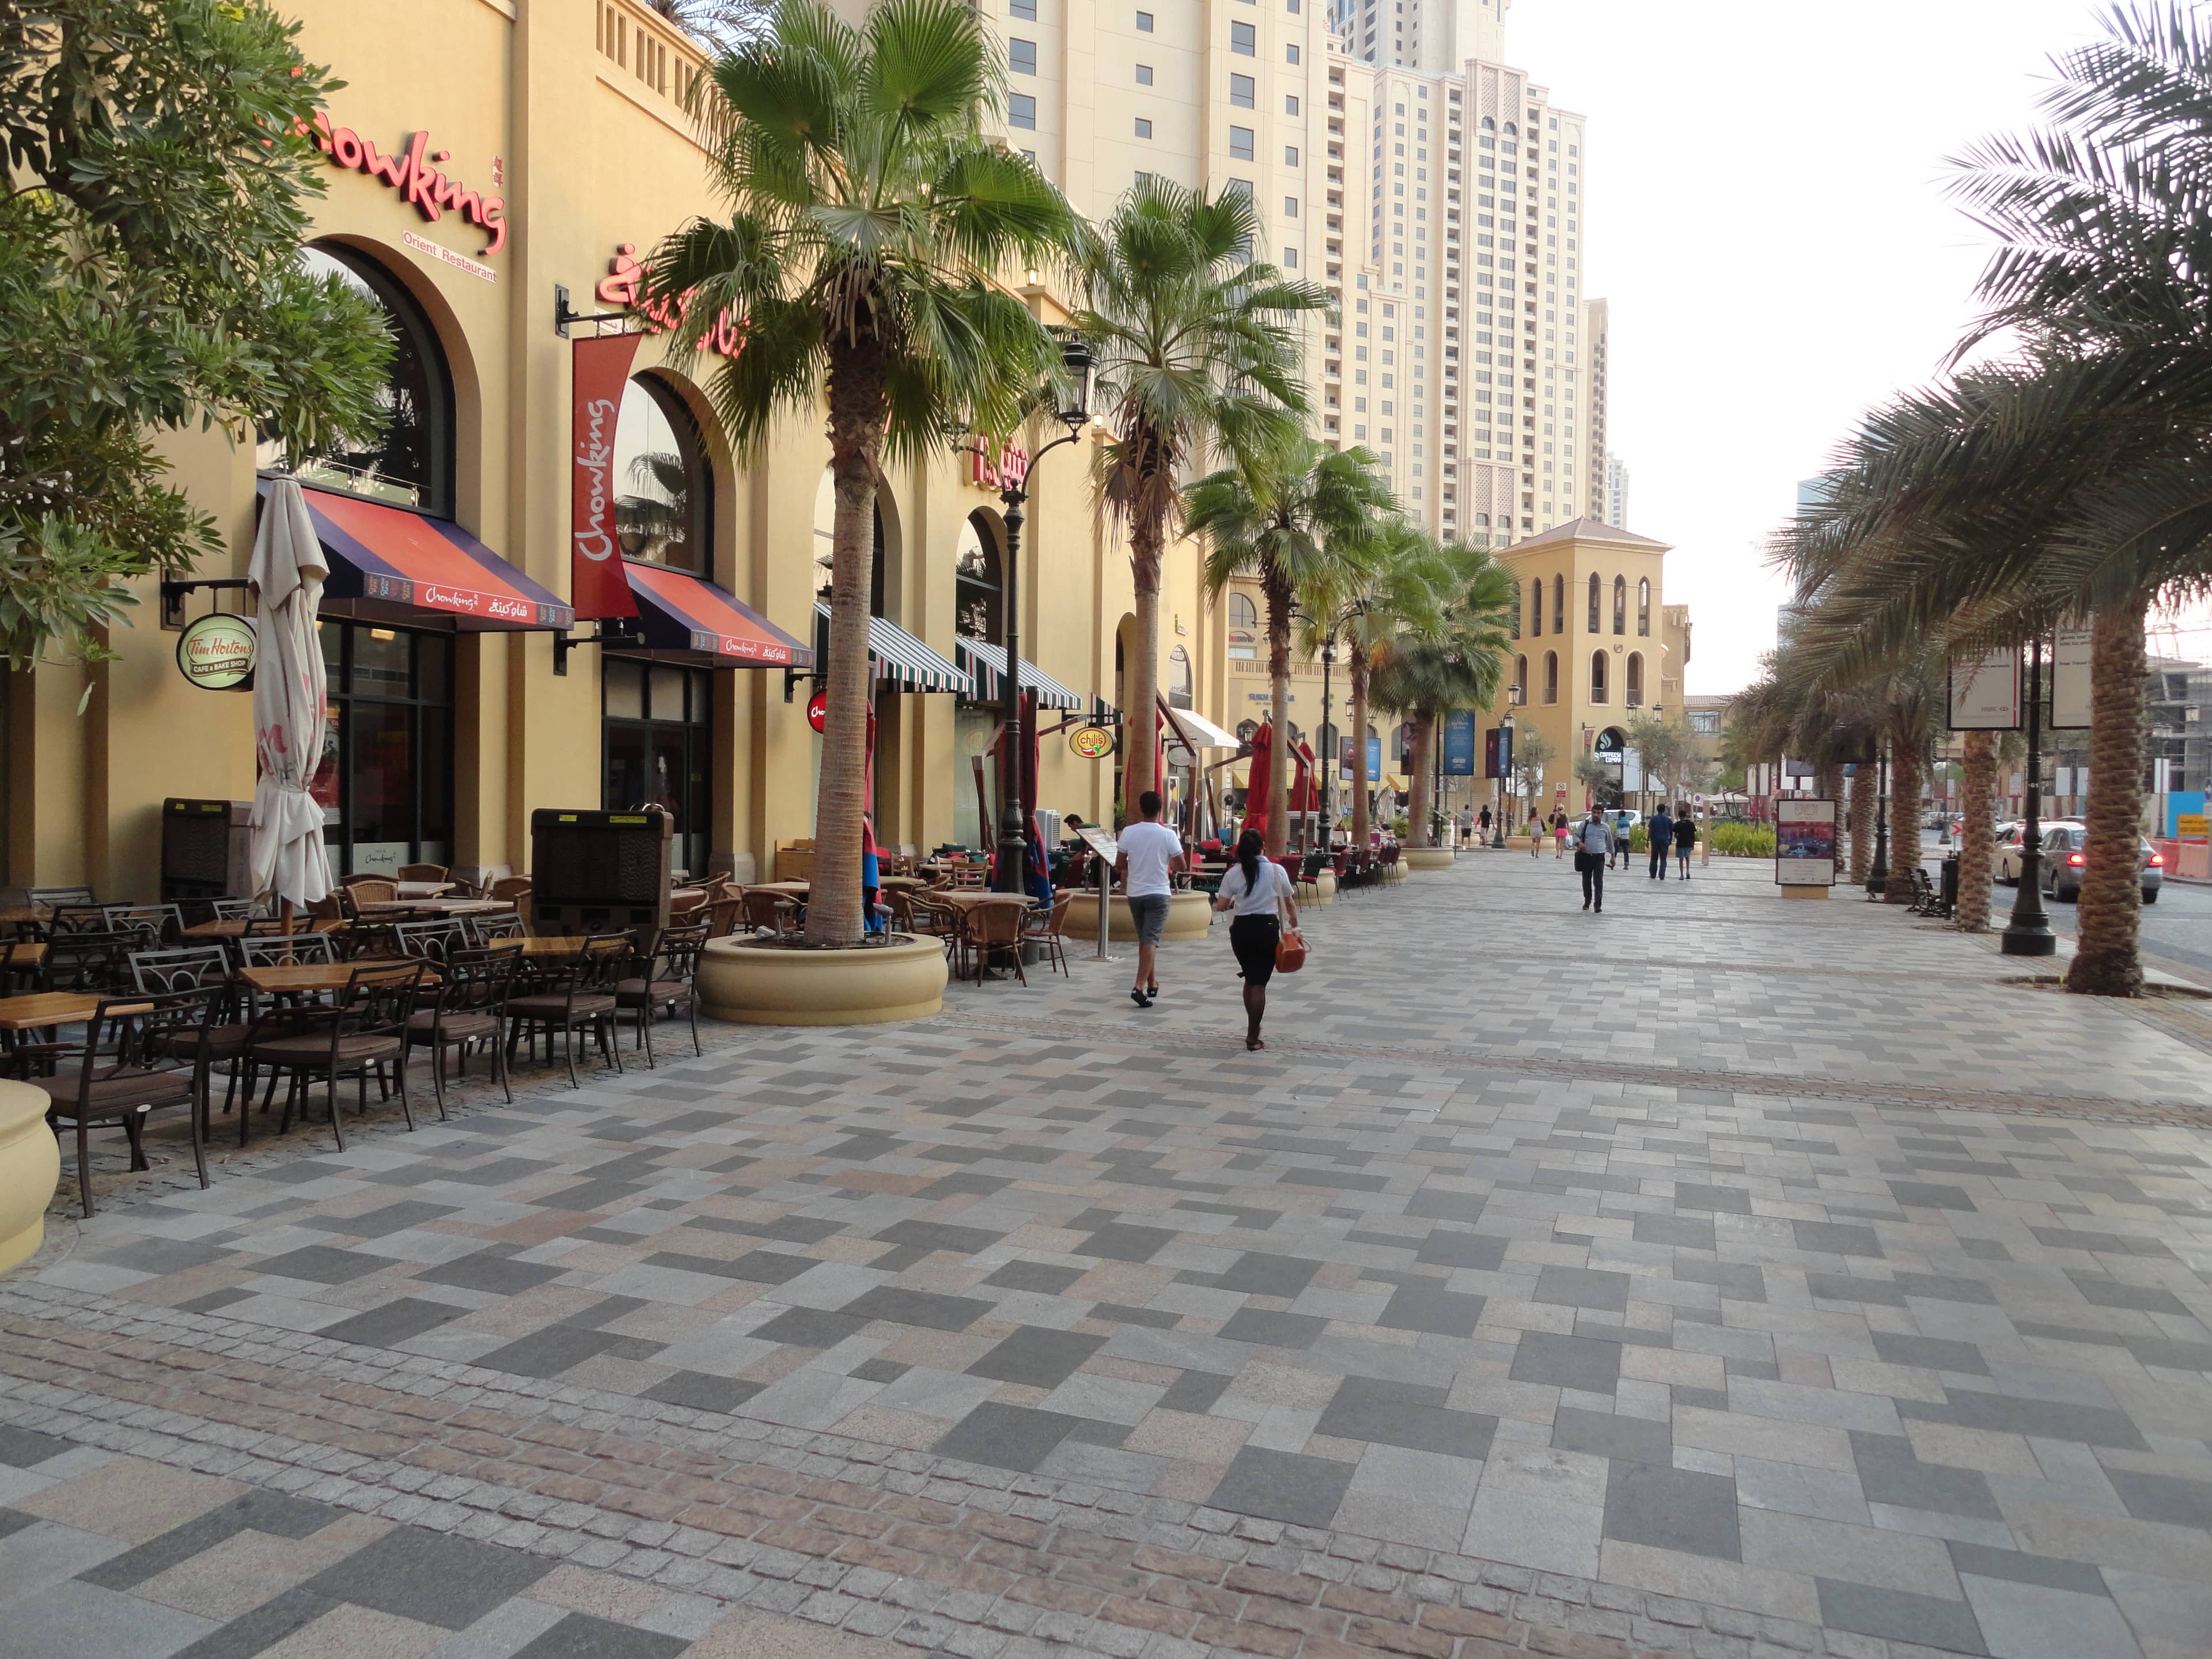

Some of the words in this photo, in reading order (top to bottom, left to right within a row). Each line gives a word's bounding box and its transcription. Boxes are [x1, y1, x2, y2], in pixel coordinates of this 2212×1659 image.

[404, 232, 437, 256] Orient
[437, 248, 497, 283] Restaurant
[574, 399, 615, 560] Chowking
[426, 586, 474, 611] Chowking
[190, 639, 209, 655] Tim
[211, 638, 251, 654] Hortons
[726, 639, 754, 655] Chowking
[1081, 733, 1103, 747] chili's
